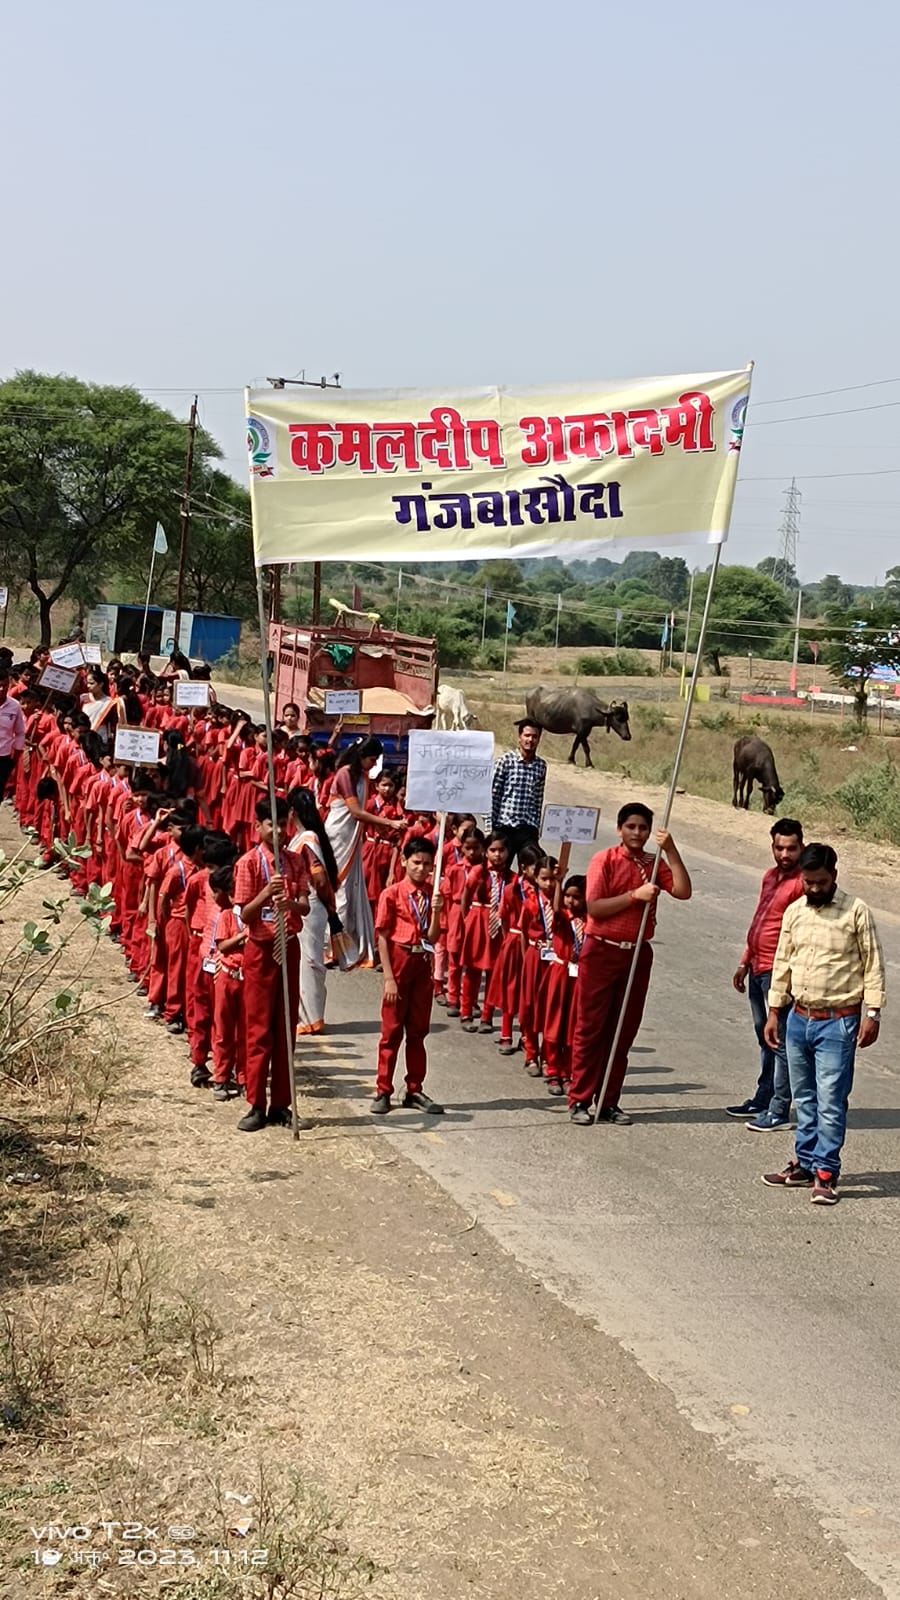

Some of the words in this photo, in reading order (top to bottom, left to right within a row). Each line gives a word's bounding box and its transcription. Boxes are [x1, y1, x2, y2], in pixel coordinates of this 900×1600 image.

[288, 407, 504, 474] कमलदीप
[519, 391, 716, 467] अकादमी
[392, 474, 623, 532] गंजबासौदा
